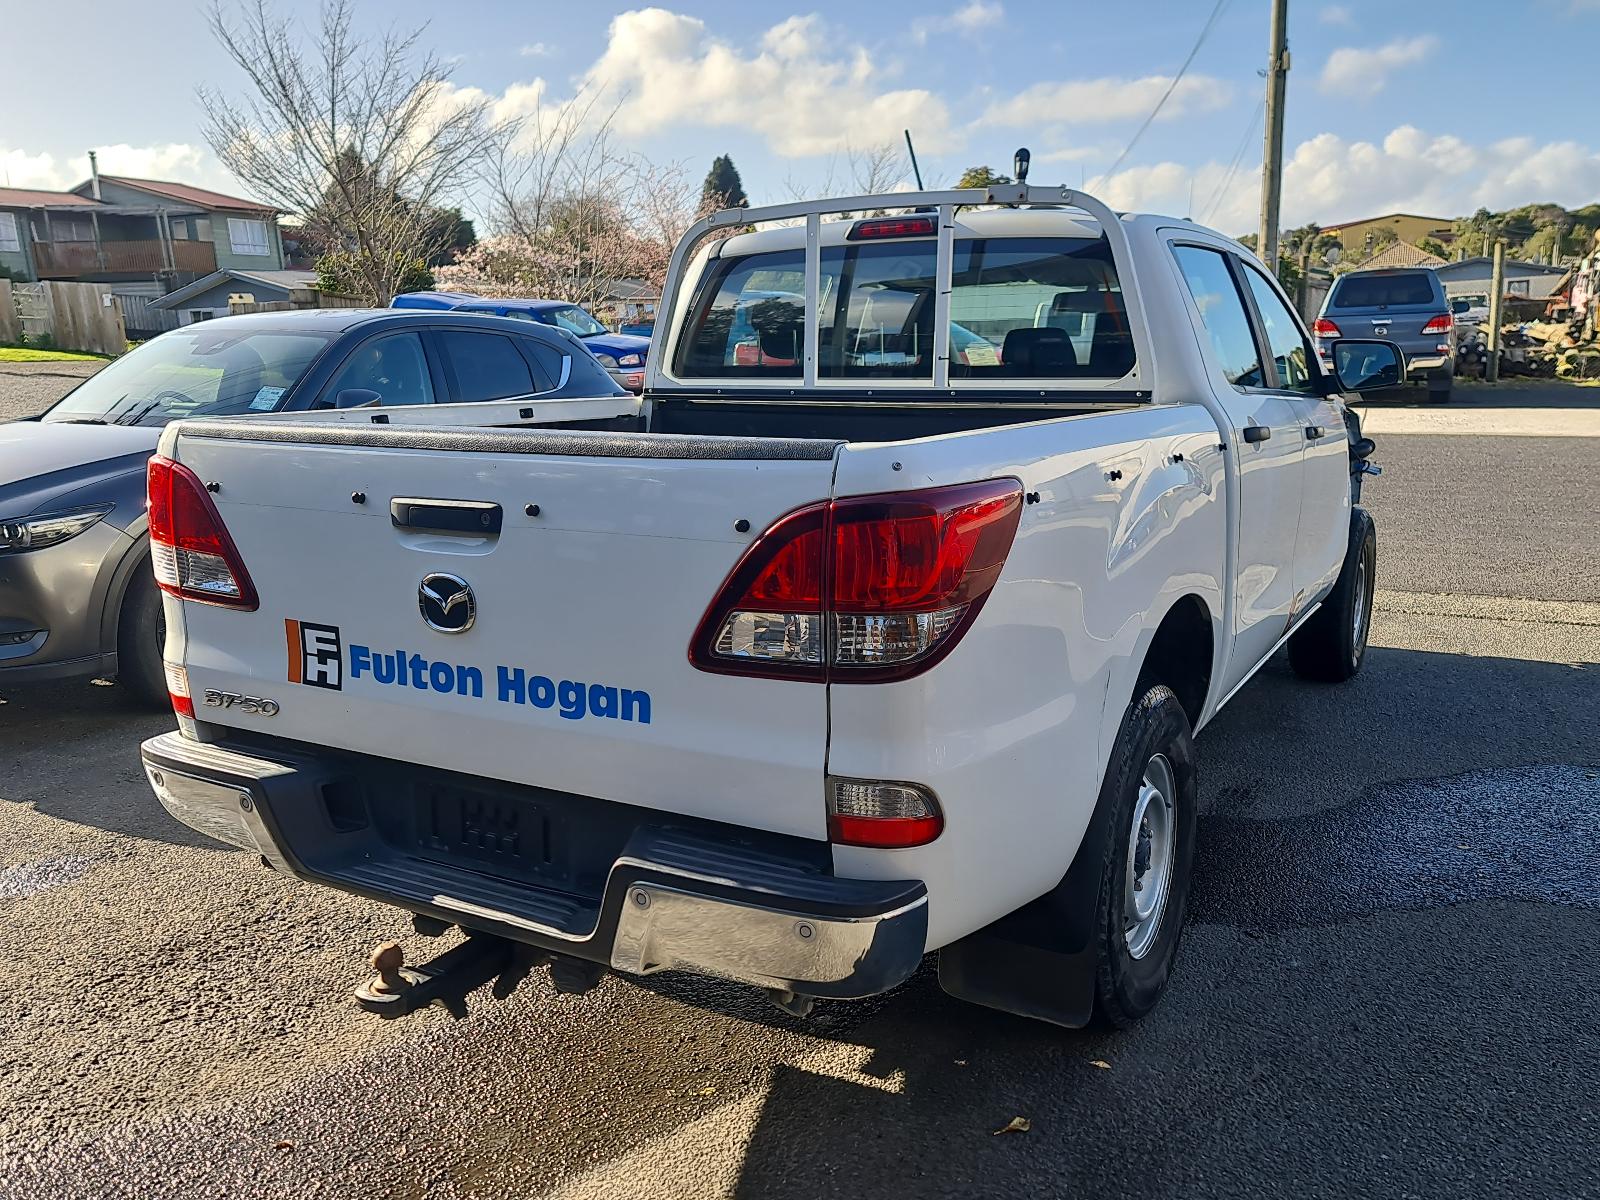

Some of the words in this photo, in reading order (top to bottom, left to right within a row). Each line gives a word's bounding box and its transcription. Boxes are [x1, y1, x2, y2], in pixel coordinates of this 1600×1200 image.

[202, 688, 279, 717] BT-50
[349, 644, 483, 698] Fulton
[497, 665, 651, 724] Hogan
